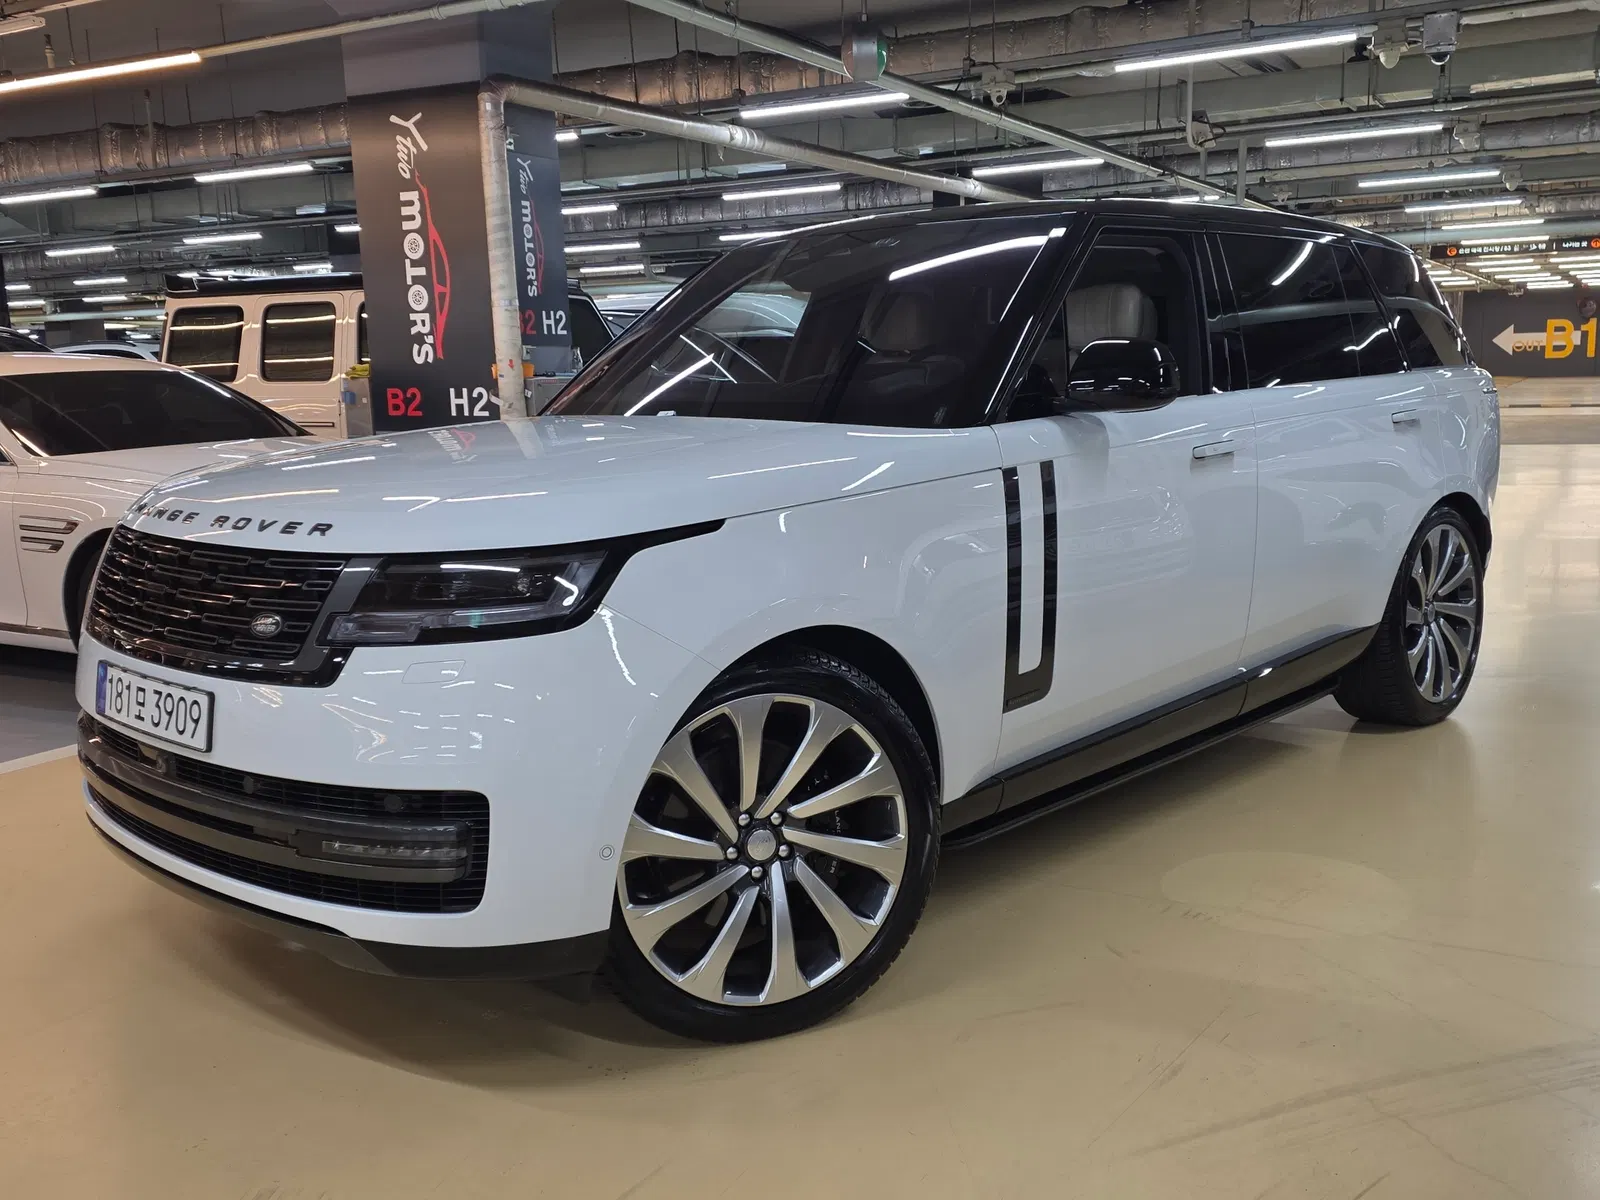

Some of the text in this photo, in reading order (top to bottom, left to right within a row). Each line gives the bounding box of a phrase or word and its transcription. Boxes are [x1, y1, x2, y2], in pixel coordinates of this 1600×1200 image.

[542, 310, 568, 335] H2
[1512, 317, 1598, 359] OUT B1
[386, 387, 490, 417] B2 H2
[210, 515, 334, 537] ROVER
[151, 689, 202, 739] 3909
